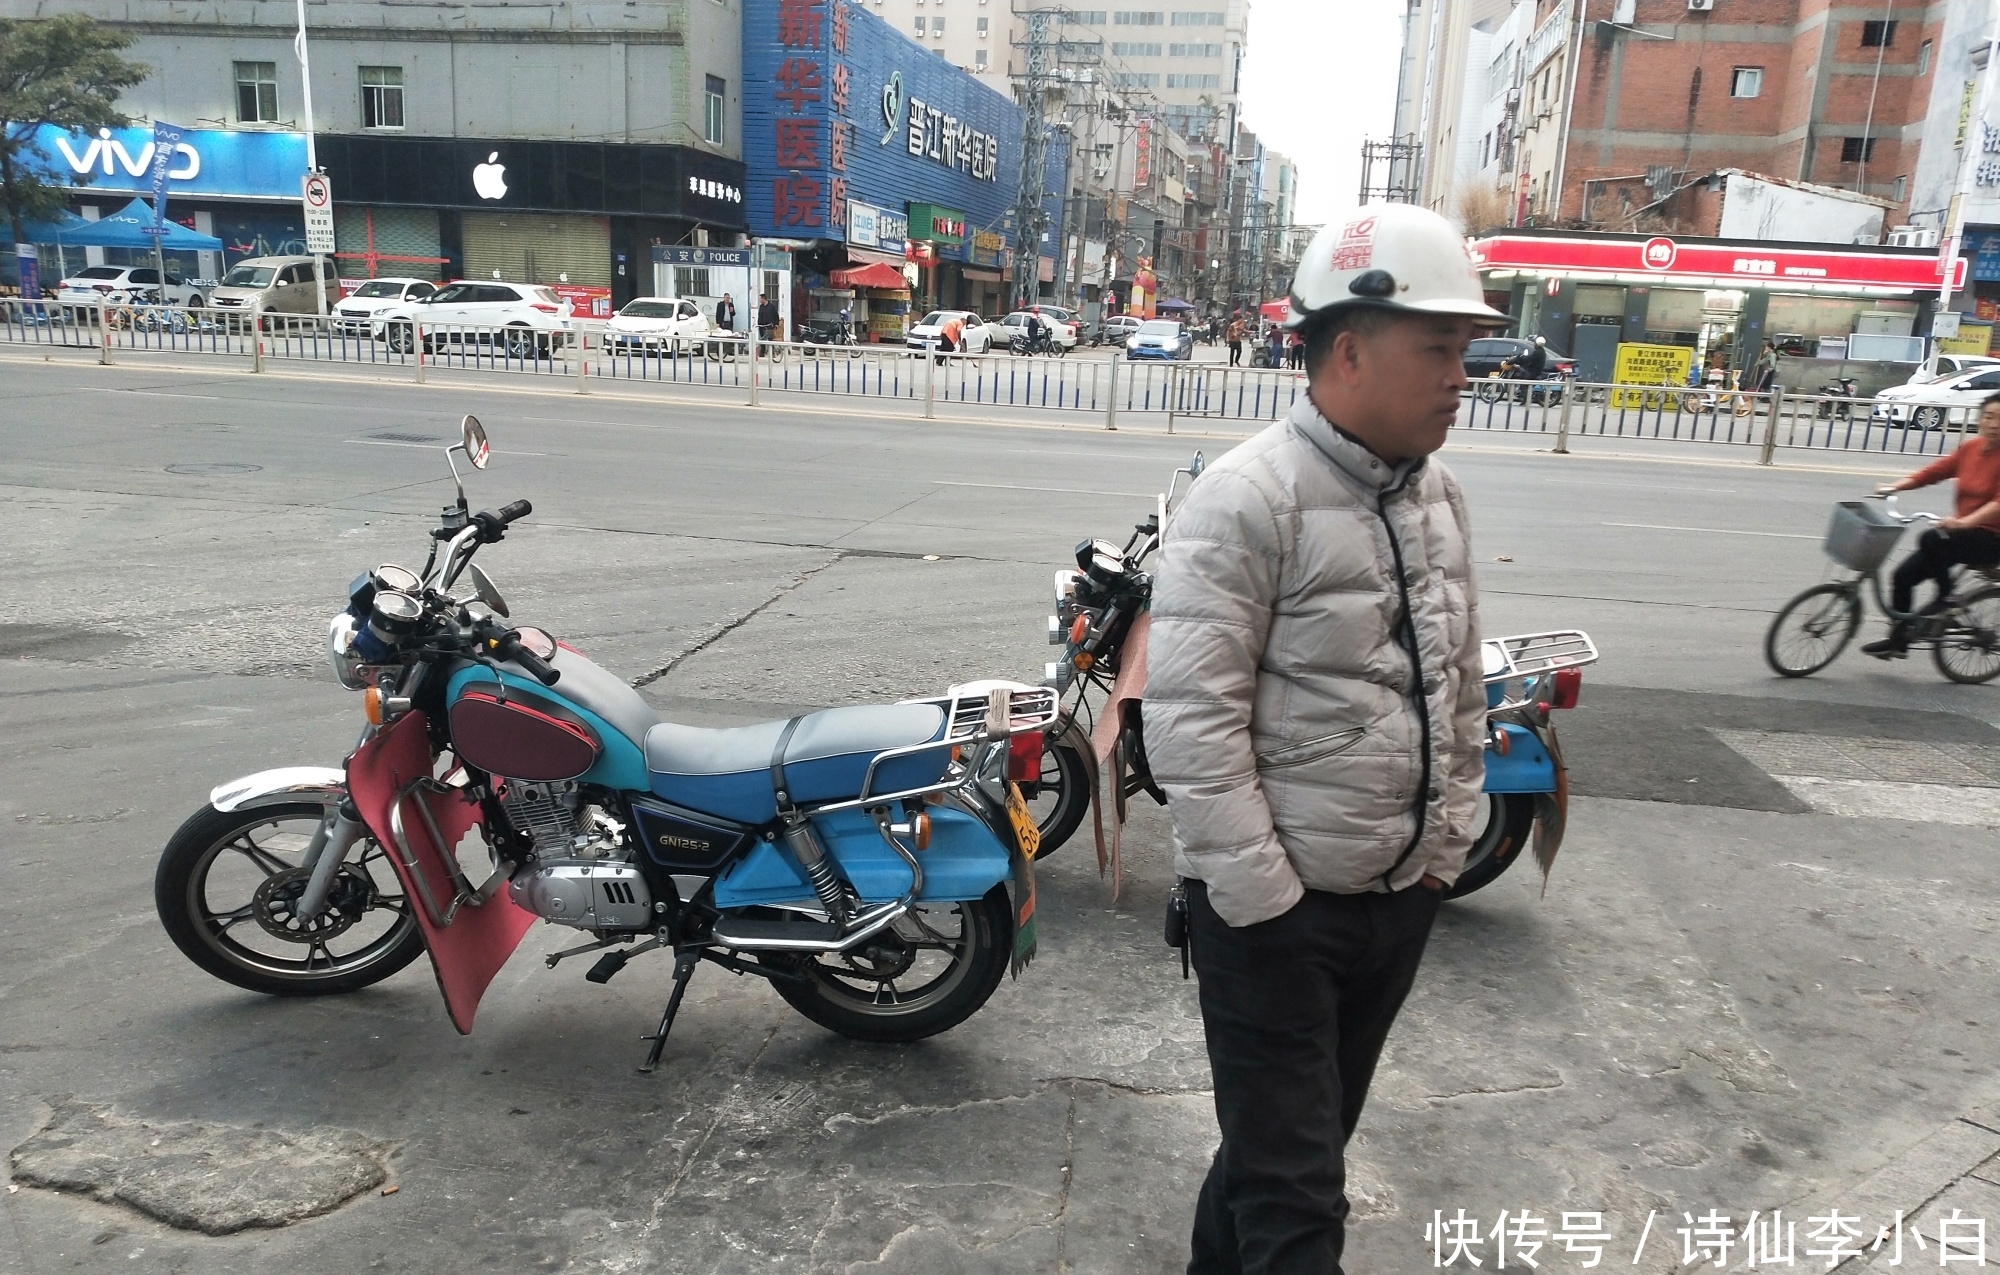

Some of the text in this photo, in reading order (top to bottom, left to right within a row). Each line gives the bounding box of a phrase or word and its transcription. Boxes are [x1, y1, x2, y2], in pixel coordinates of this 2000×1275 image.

[774, 0, 824, 227] 新华医院
[829, 3, 848, 227] 新华医院
[154, 128, 180, 140] vivo
[908, 96, 997, 182] 晋江新华医院
[56, 127, 200, 180] vivo
[689, 176, 741, 203] 苹果服务中心
[109, 216, 139, 224] vivo
[234, 233, 308, 256] vivo
[662, 249, 740, 263] 公安 POLICE
[659, 835, 710, 852] GN125-2
